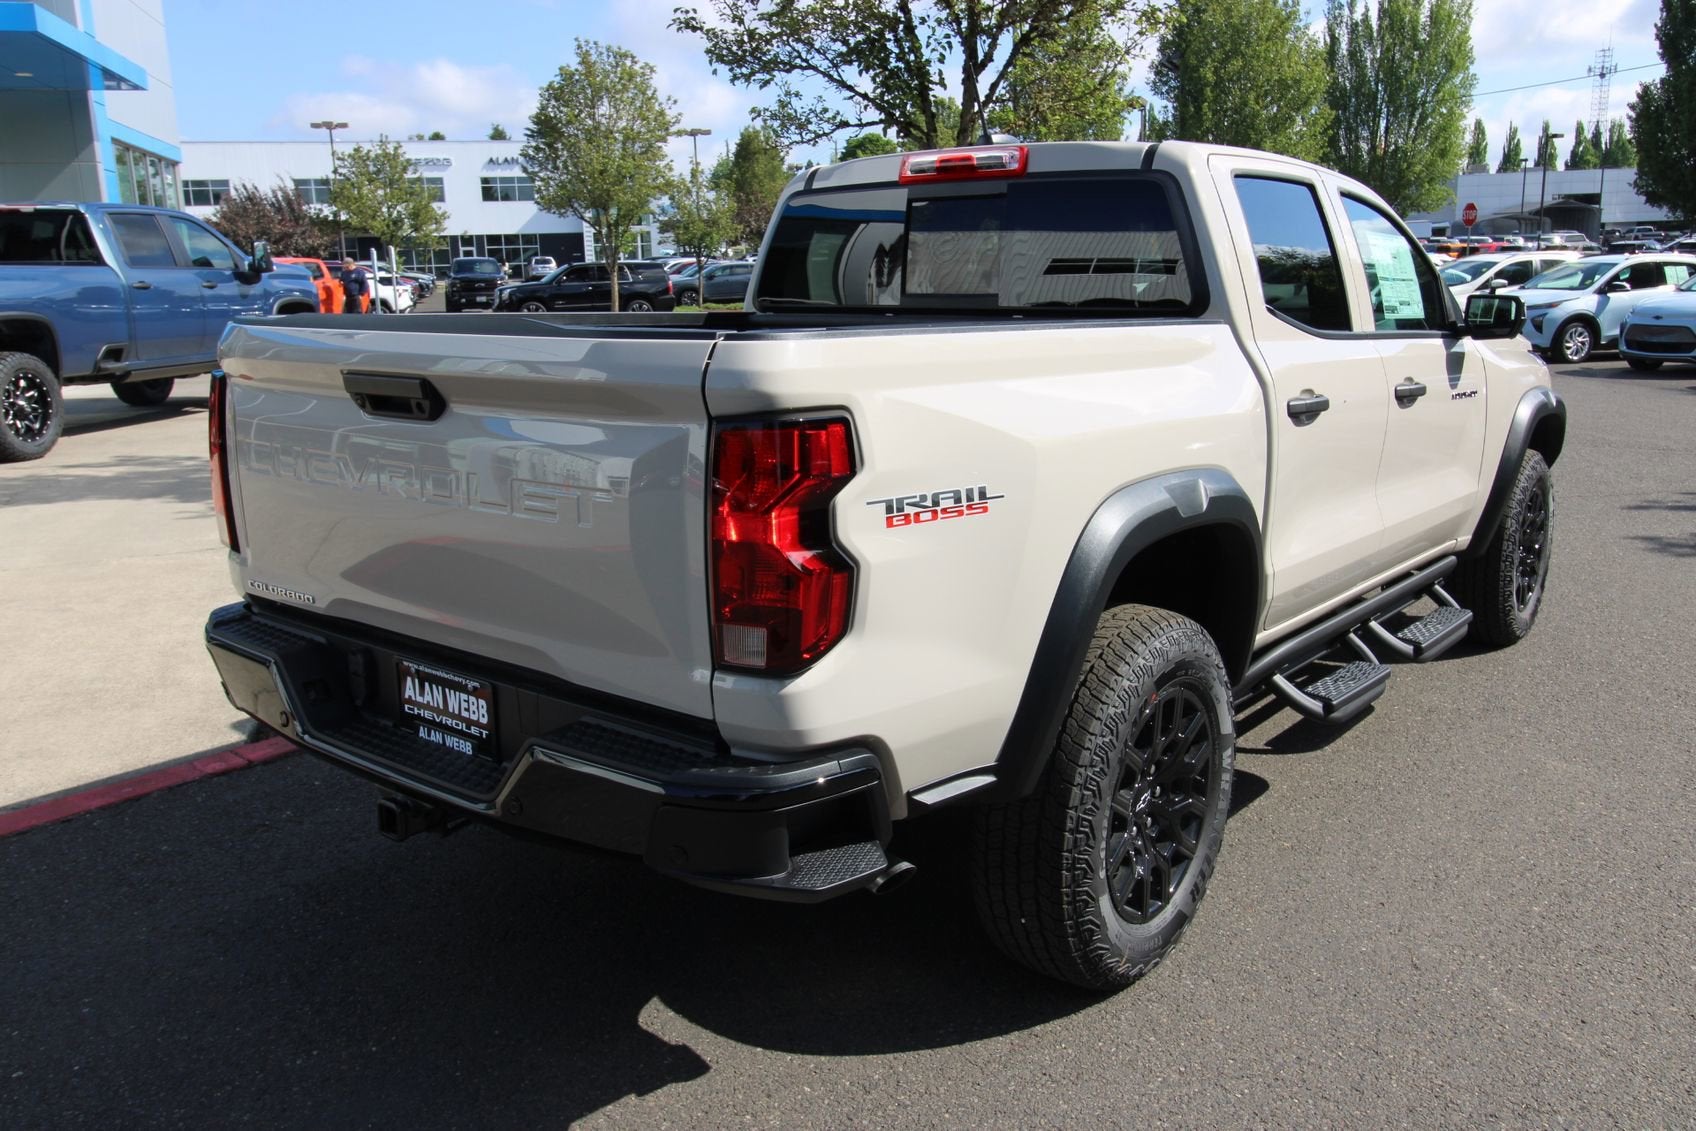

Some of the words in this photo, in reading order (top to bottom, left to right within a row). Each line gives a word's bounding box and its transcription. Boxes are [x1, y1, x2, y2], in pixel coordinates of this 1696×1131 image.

[487, 156, 520, 166] ALAN
[1463, 210, 1477, 220] STOP
[241, 440, 614, 528] CHEVROLET
[866, 485, 1005, 516] TRAIL
[885, 501, 989, 528] BOSS
[248, 579, 315, 604] COLORADO
[404, 676, 444, 710] ALAN
[445, 687, 489, 725] WEBB
[404, 703, 489, 739] CHEVROLET
[418, 725, 443, 745] ALAN
[443, 733, 473, 755] WEBB
